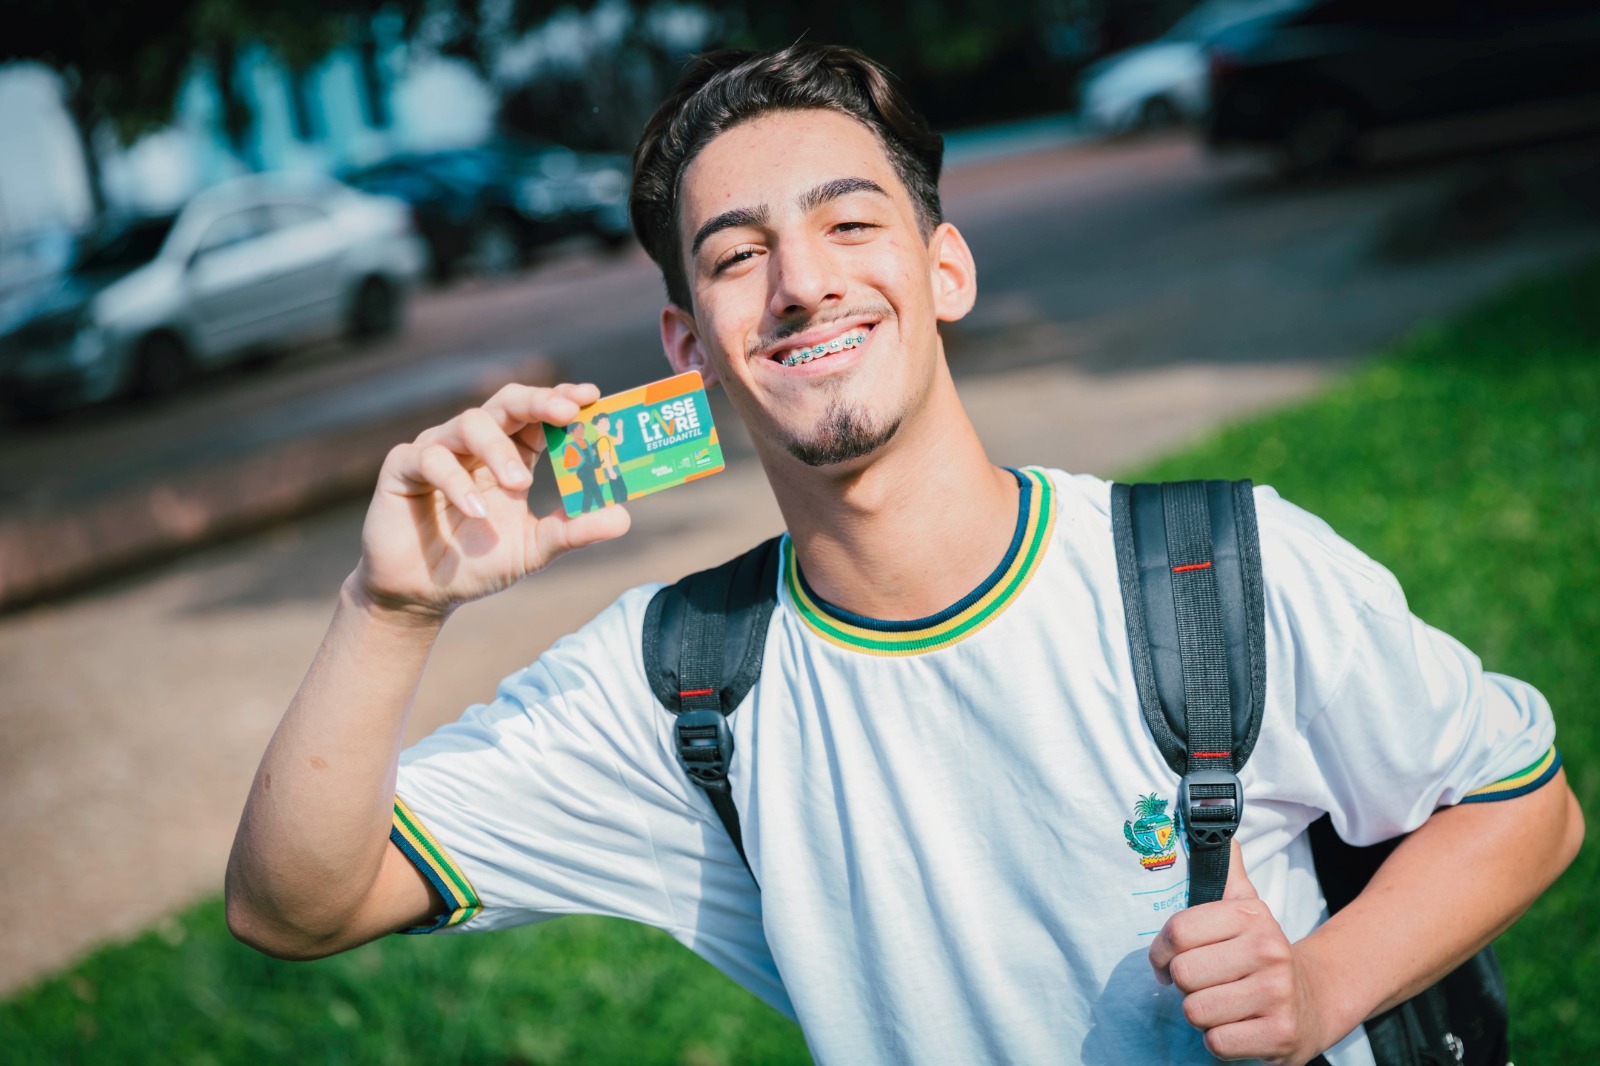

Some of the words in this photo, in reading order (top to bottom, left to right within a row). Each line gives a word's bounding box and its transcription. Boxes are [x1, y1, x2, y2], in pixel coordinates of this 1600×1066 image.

[637, 397, 695, 428] PASSE
[641, 412, 700, 443] LIVRE
[646, 428, 702, 451] ESTUDANTIL
